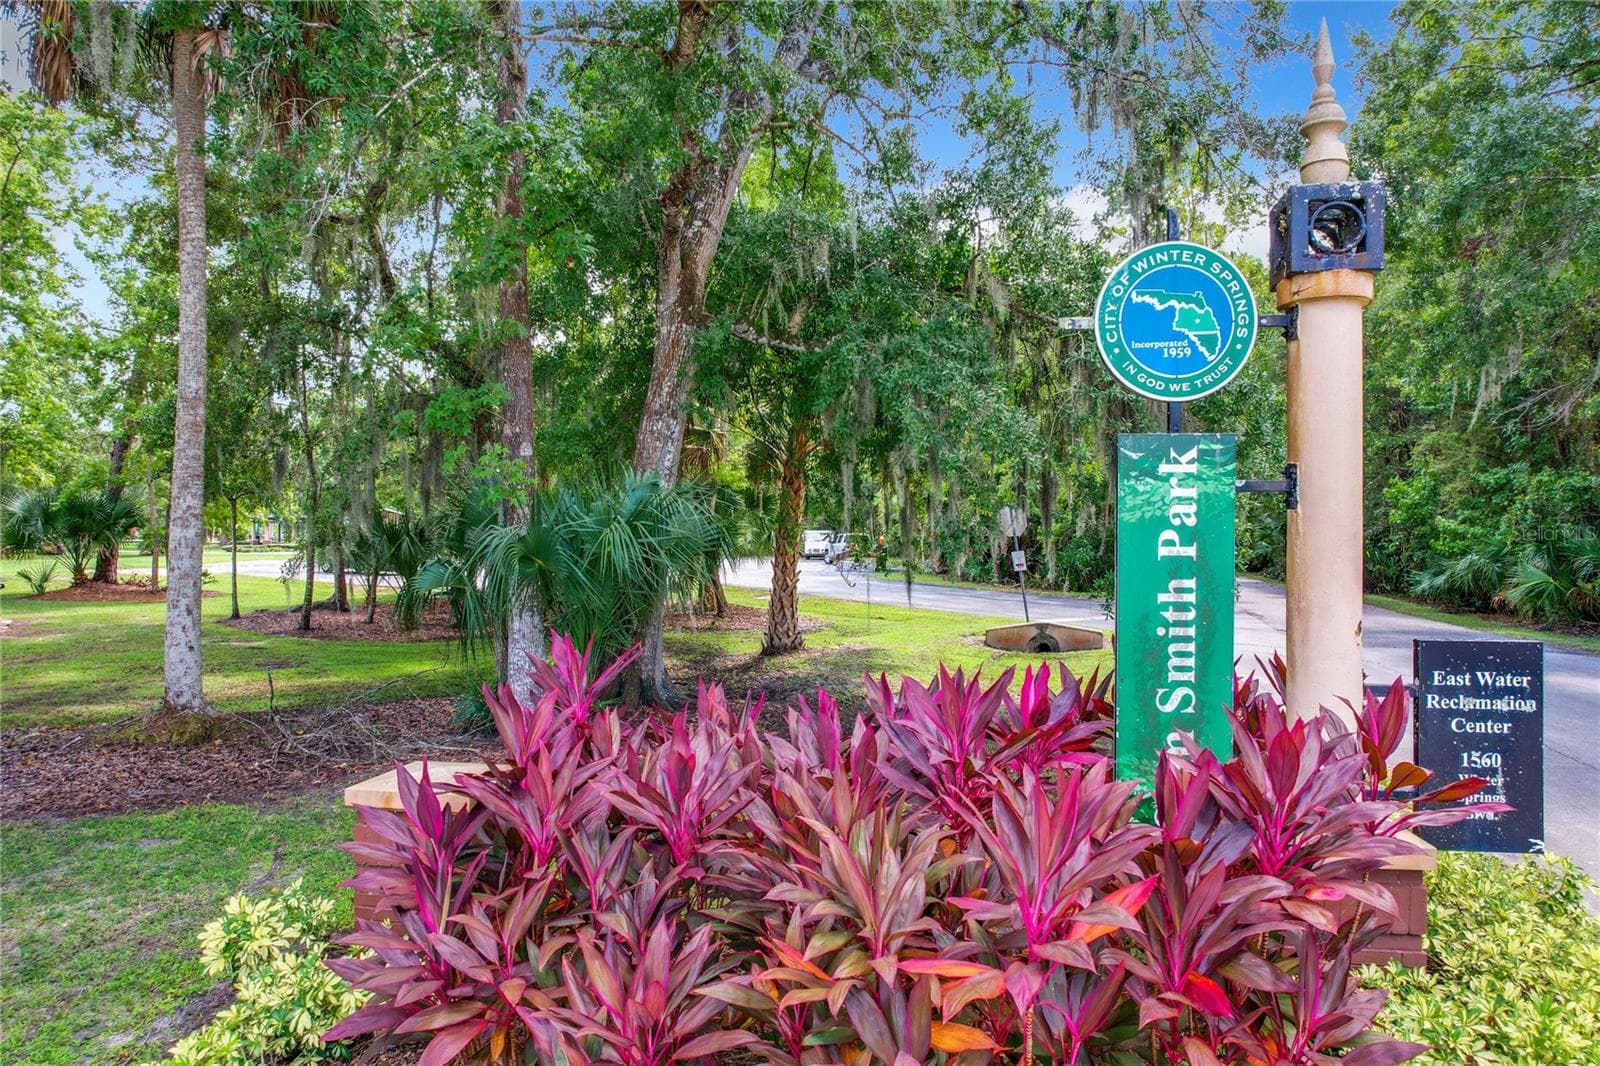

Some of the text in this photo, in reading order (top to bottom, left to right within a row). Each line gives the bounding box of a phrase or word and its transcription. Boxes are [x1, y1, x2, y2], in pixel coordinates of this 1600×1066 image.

[1104, 250, 1249, 343] CITY OF WINTER SPRINGS
[1131, 340, 1189, 349] Incorporated
[1163, 347, 1192, 358] 1959
[1122, 357, 1233, 392] IN GOD WE TRUST
[1157, 445, 1199, 562] Park
[1156, 576, 1197, 714] Smith
[1432, 671, 1532, 687] East Water
[1426, 694, 1537, 711] Reclamation
[1451, 717, 1512, 734] Center
[1461, 751, 1502, 768] 1560
